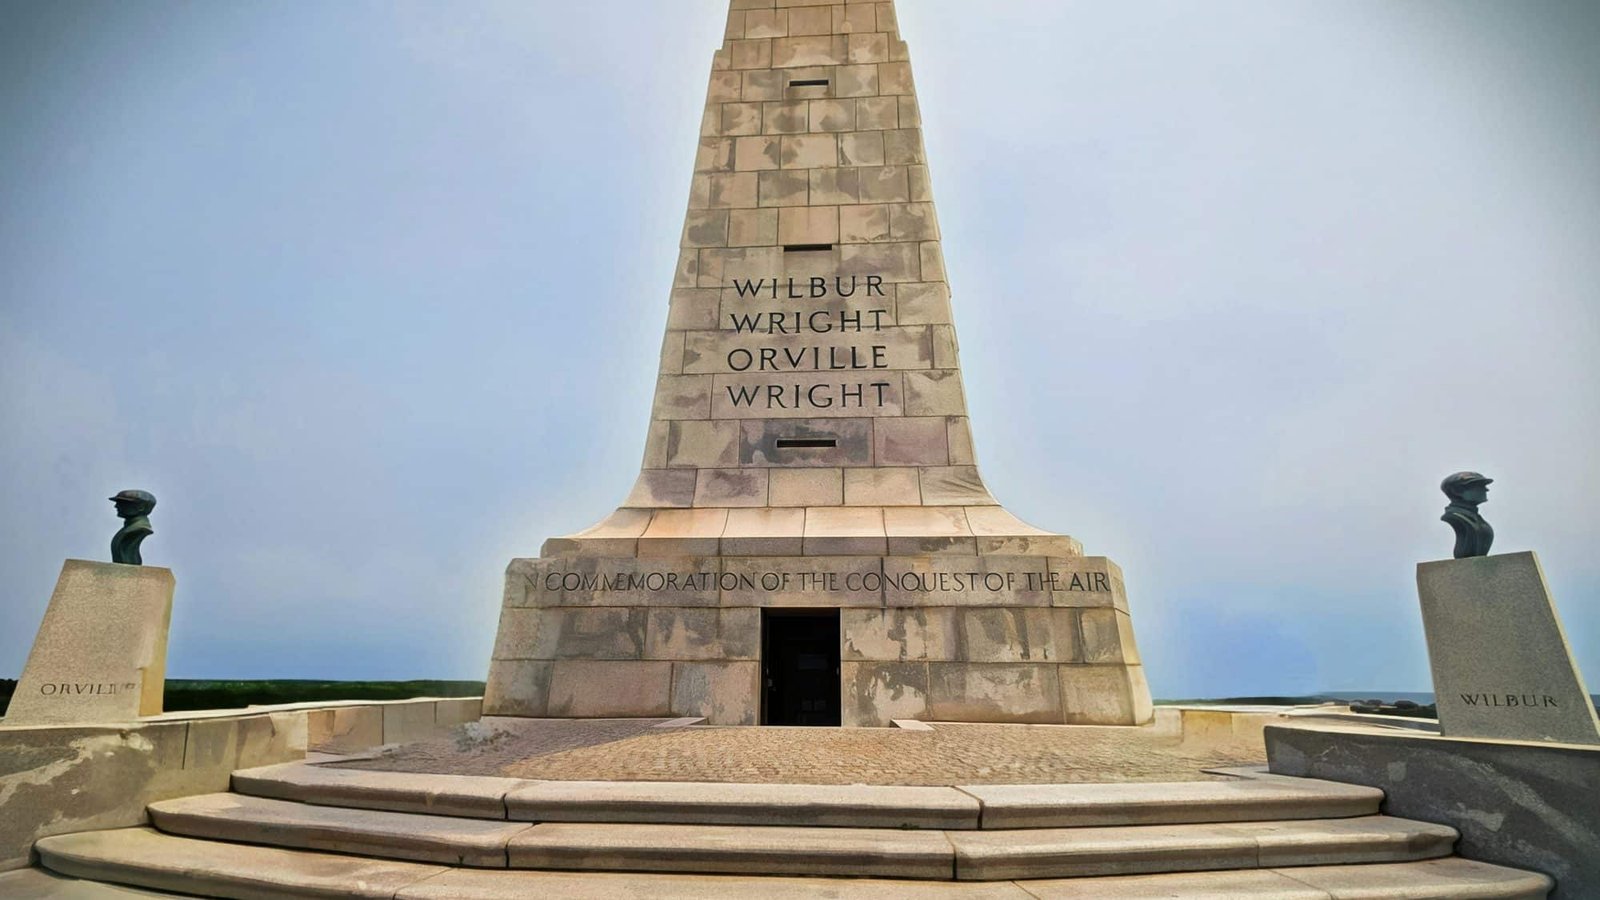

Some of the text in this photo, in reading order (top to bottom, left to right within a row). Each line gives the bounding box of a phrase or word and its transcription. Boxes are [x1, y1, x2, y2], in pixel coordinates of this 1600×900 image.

[733, 275, 885, 299] WILBUR
[730, 309, 887, 335] WRIGHT
[727, 345, 889, 371] ORVILLE
[726, 382, 890, 409] WRIGHT
[545, 572, 754, 592] COMMEMORATION
[761, 572, 791, 592] OF
[797, 572, 840, 592] THE
[845, 572, 979, 593] CONQUEST
[984, 571, 1015, 592] OF
[1023, 571, 1059, 592] THE
[1069, 572, 1111, 592] AIR
[40, 682, 136, 696] ORVIL
[1460, 693, 1558, 708] WILBUR
